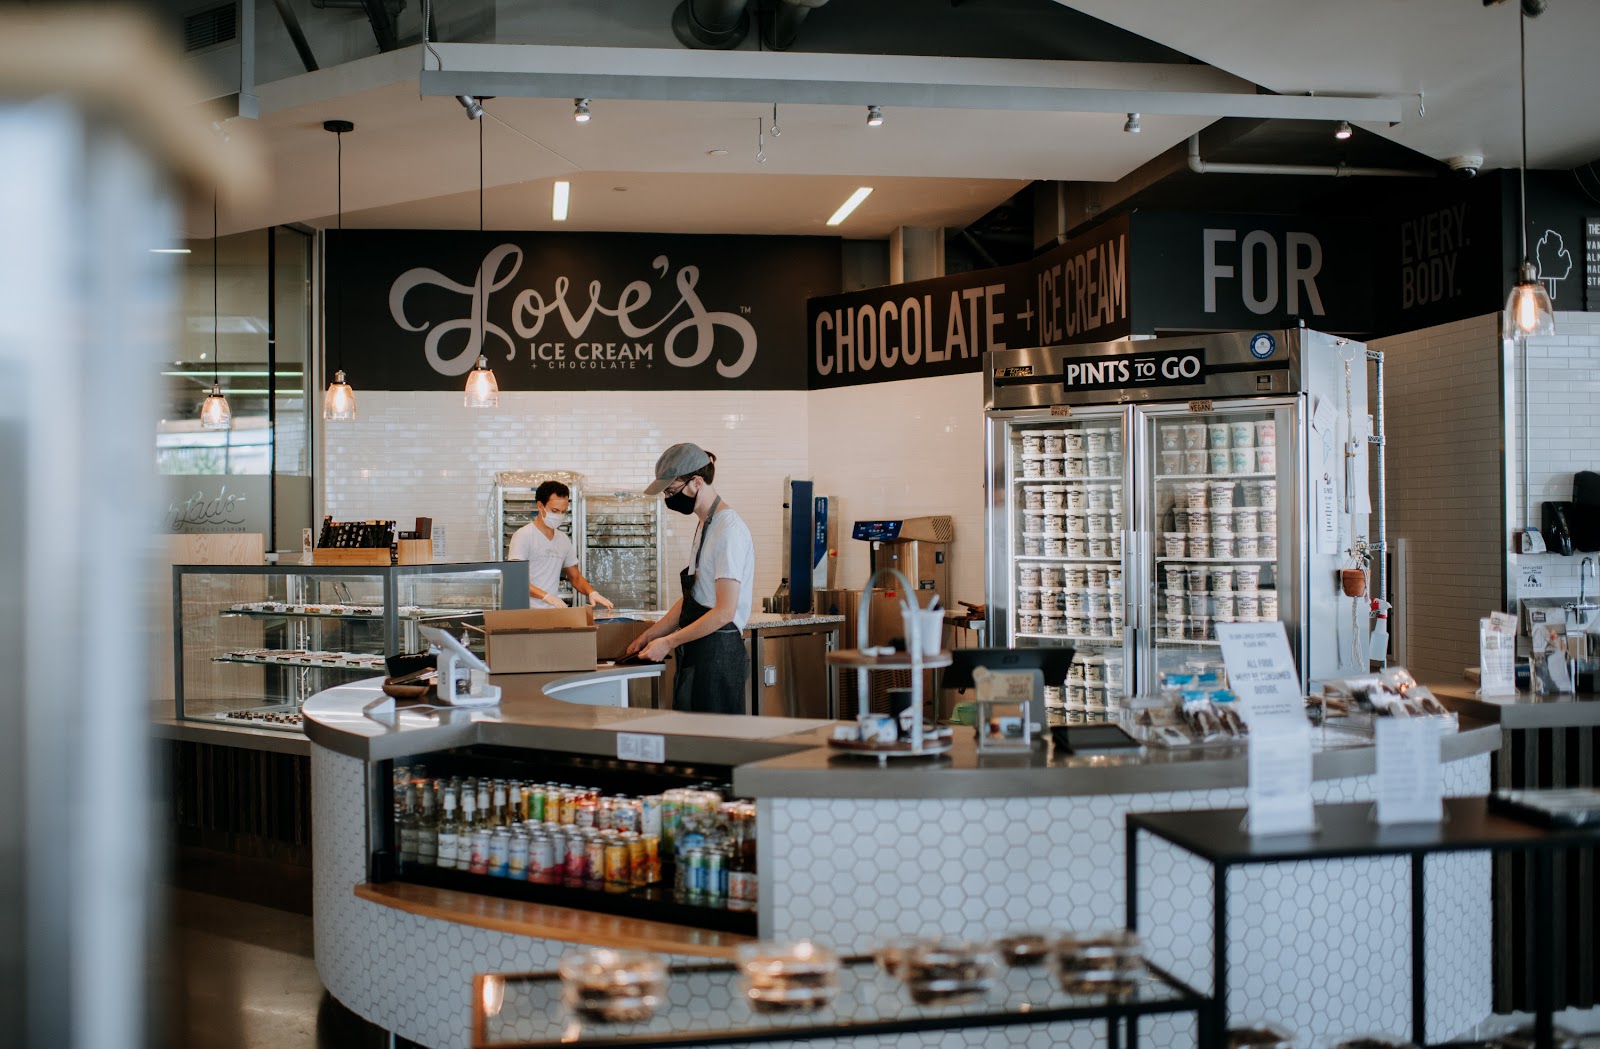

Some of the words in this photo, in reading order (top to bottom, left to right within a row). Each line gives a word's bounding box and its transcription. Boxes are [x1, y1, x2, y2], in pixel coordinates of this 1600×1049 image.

[1401, 201, 1470, 265] EVERY.
[1203, 228, 1326, 317] FOR
[1402, 251, 1461, 310] BODY.
[388, 243, 758, 379] Love's
[815, 283, 1007, 376] CHOCOLATE
[1038, 264, 1063, 347] ICE
[1065, 233, 1127, 338] CREAM
[530, 342, 565, 360] ICE
[574, 342, 654, 360] CREAM
[548, 361, 636, 369] CHOCOLATE
[1067, 360, 1130, 385] PINTS
[1134, 362, 1156, 377] TO
[1161, 355, 1201, 379] GO
[1190, 403, 1211, 412] VEGAN
[1246, 659, 1258, 668] ALL
[1258, 659, 1274, 668] FOOD
